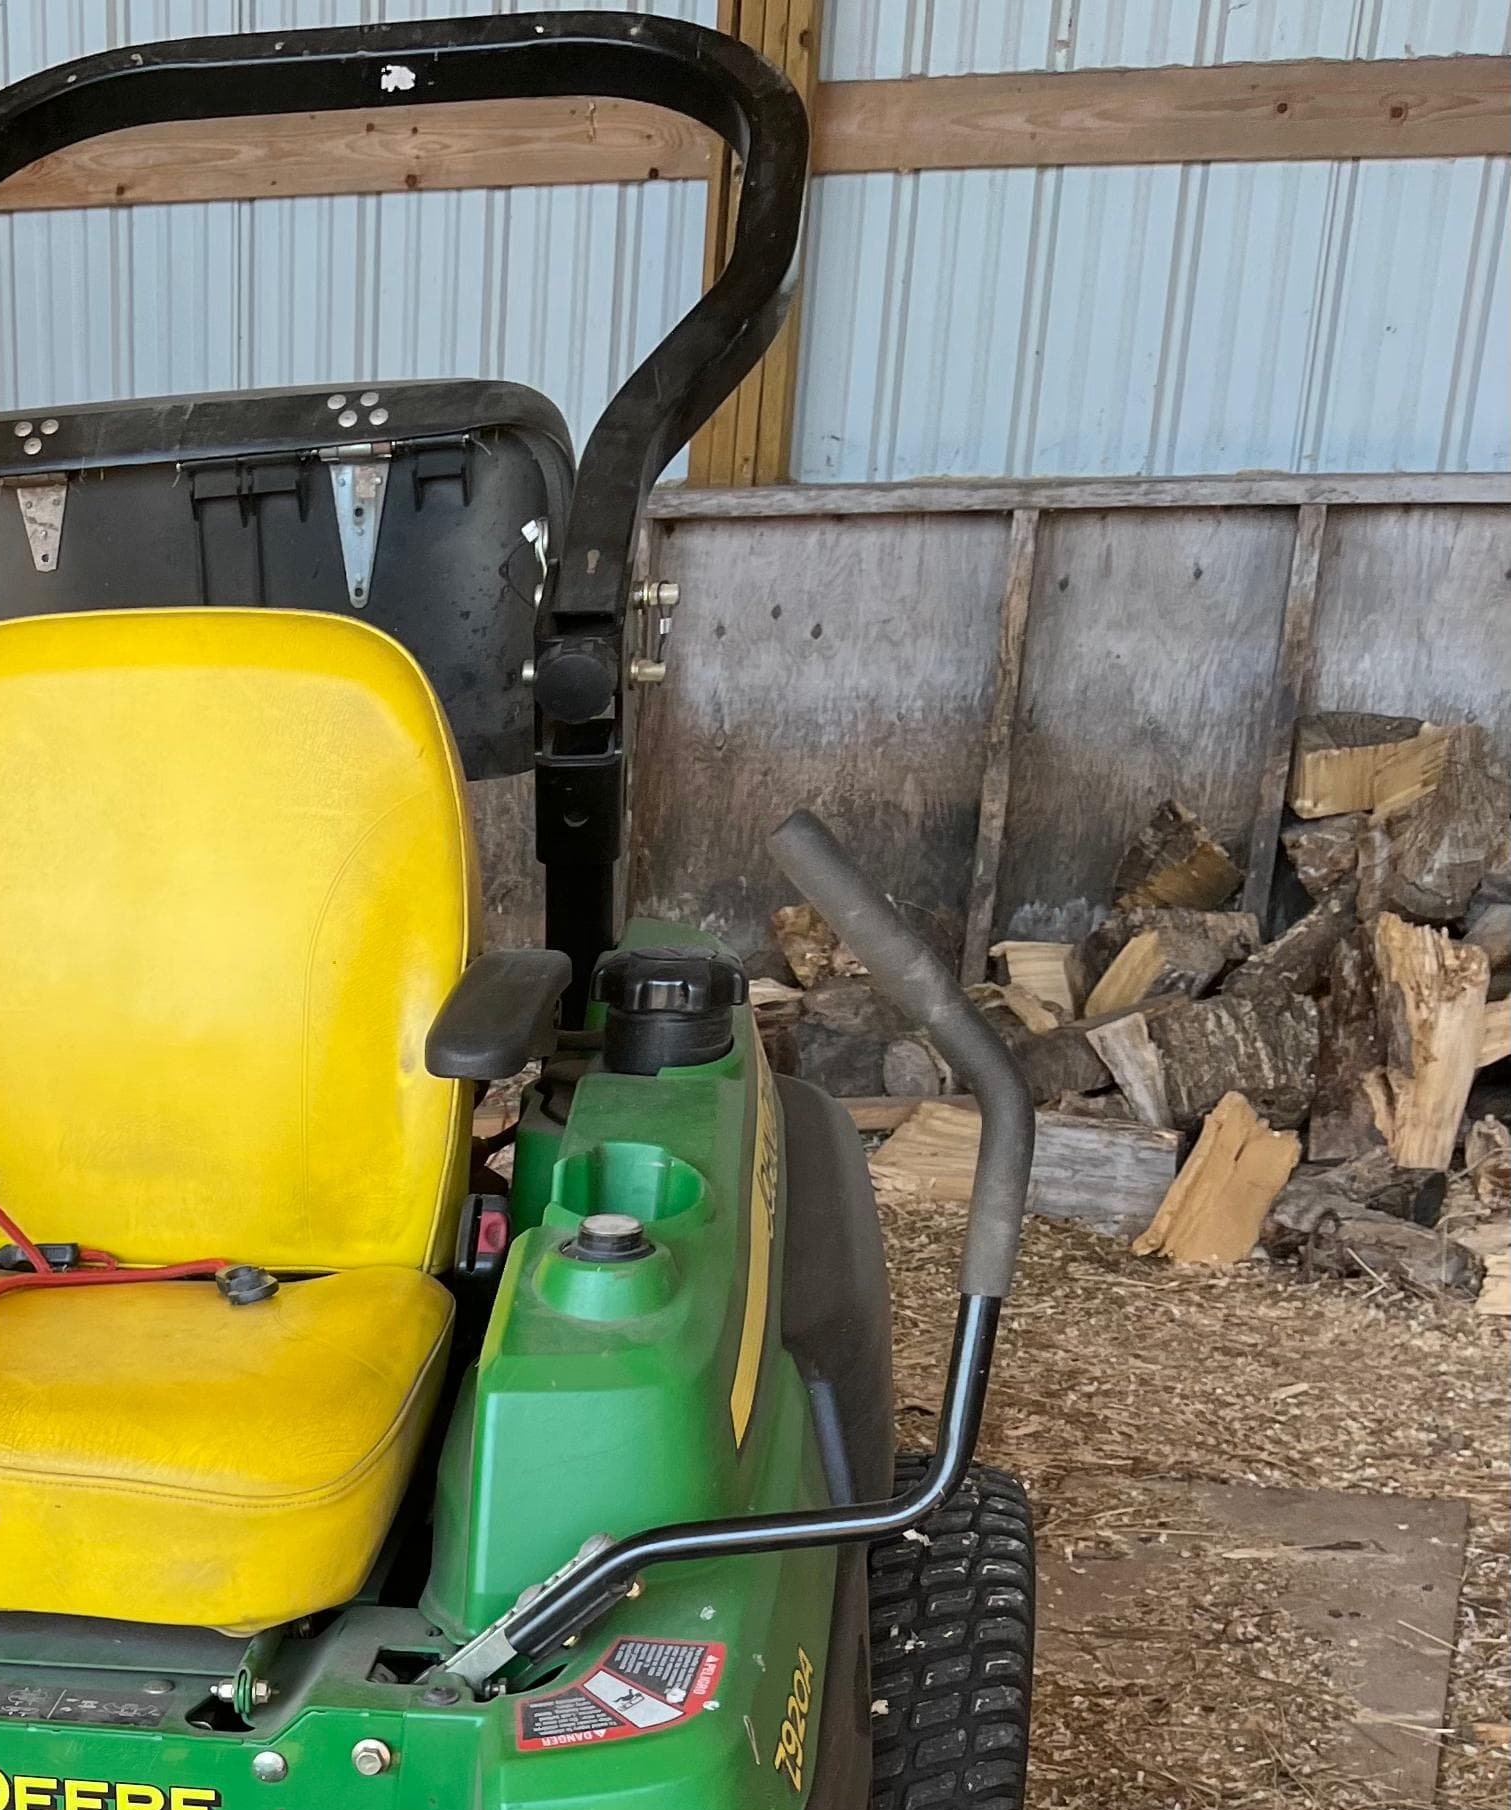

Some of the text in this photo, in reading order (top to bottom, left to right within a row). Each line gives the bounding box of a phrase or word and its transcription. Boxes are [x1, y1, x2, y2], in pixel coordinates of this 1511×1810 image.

[693, 1661, 717, 1695] PELIGRO
[774, 1647, 813, 1792] Z920A
[542, 1730, 593, 1747] DANGER
